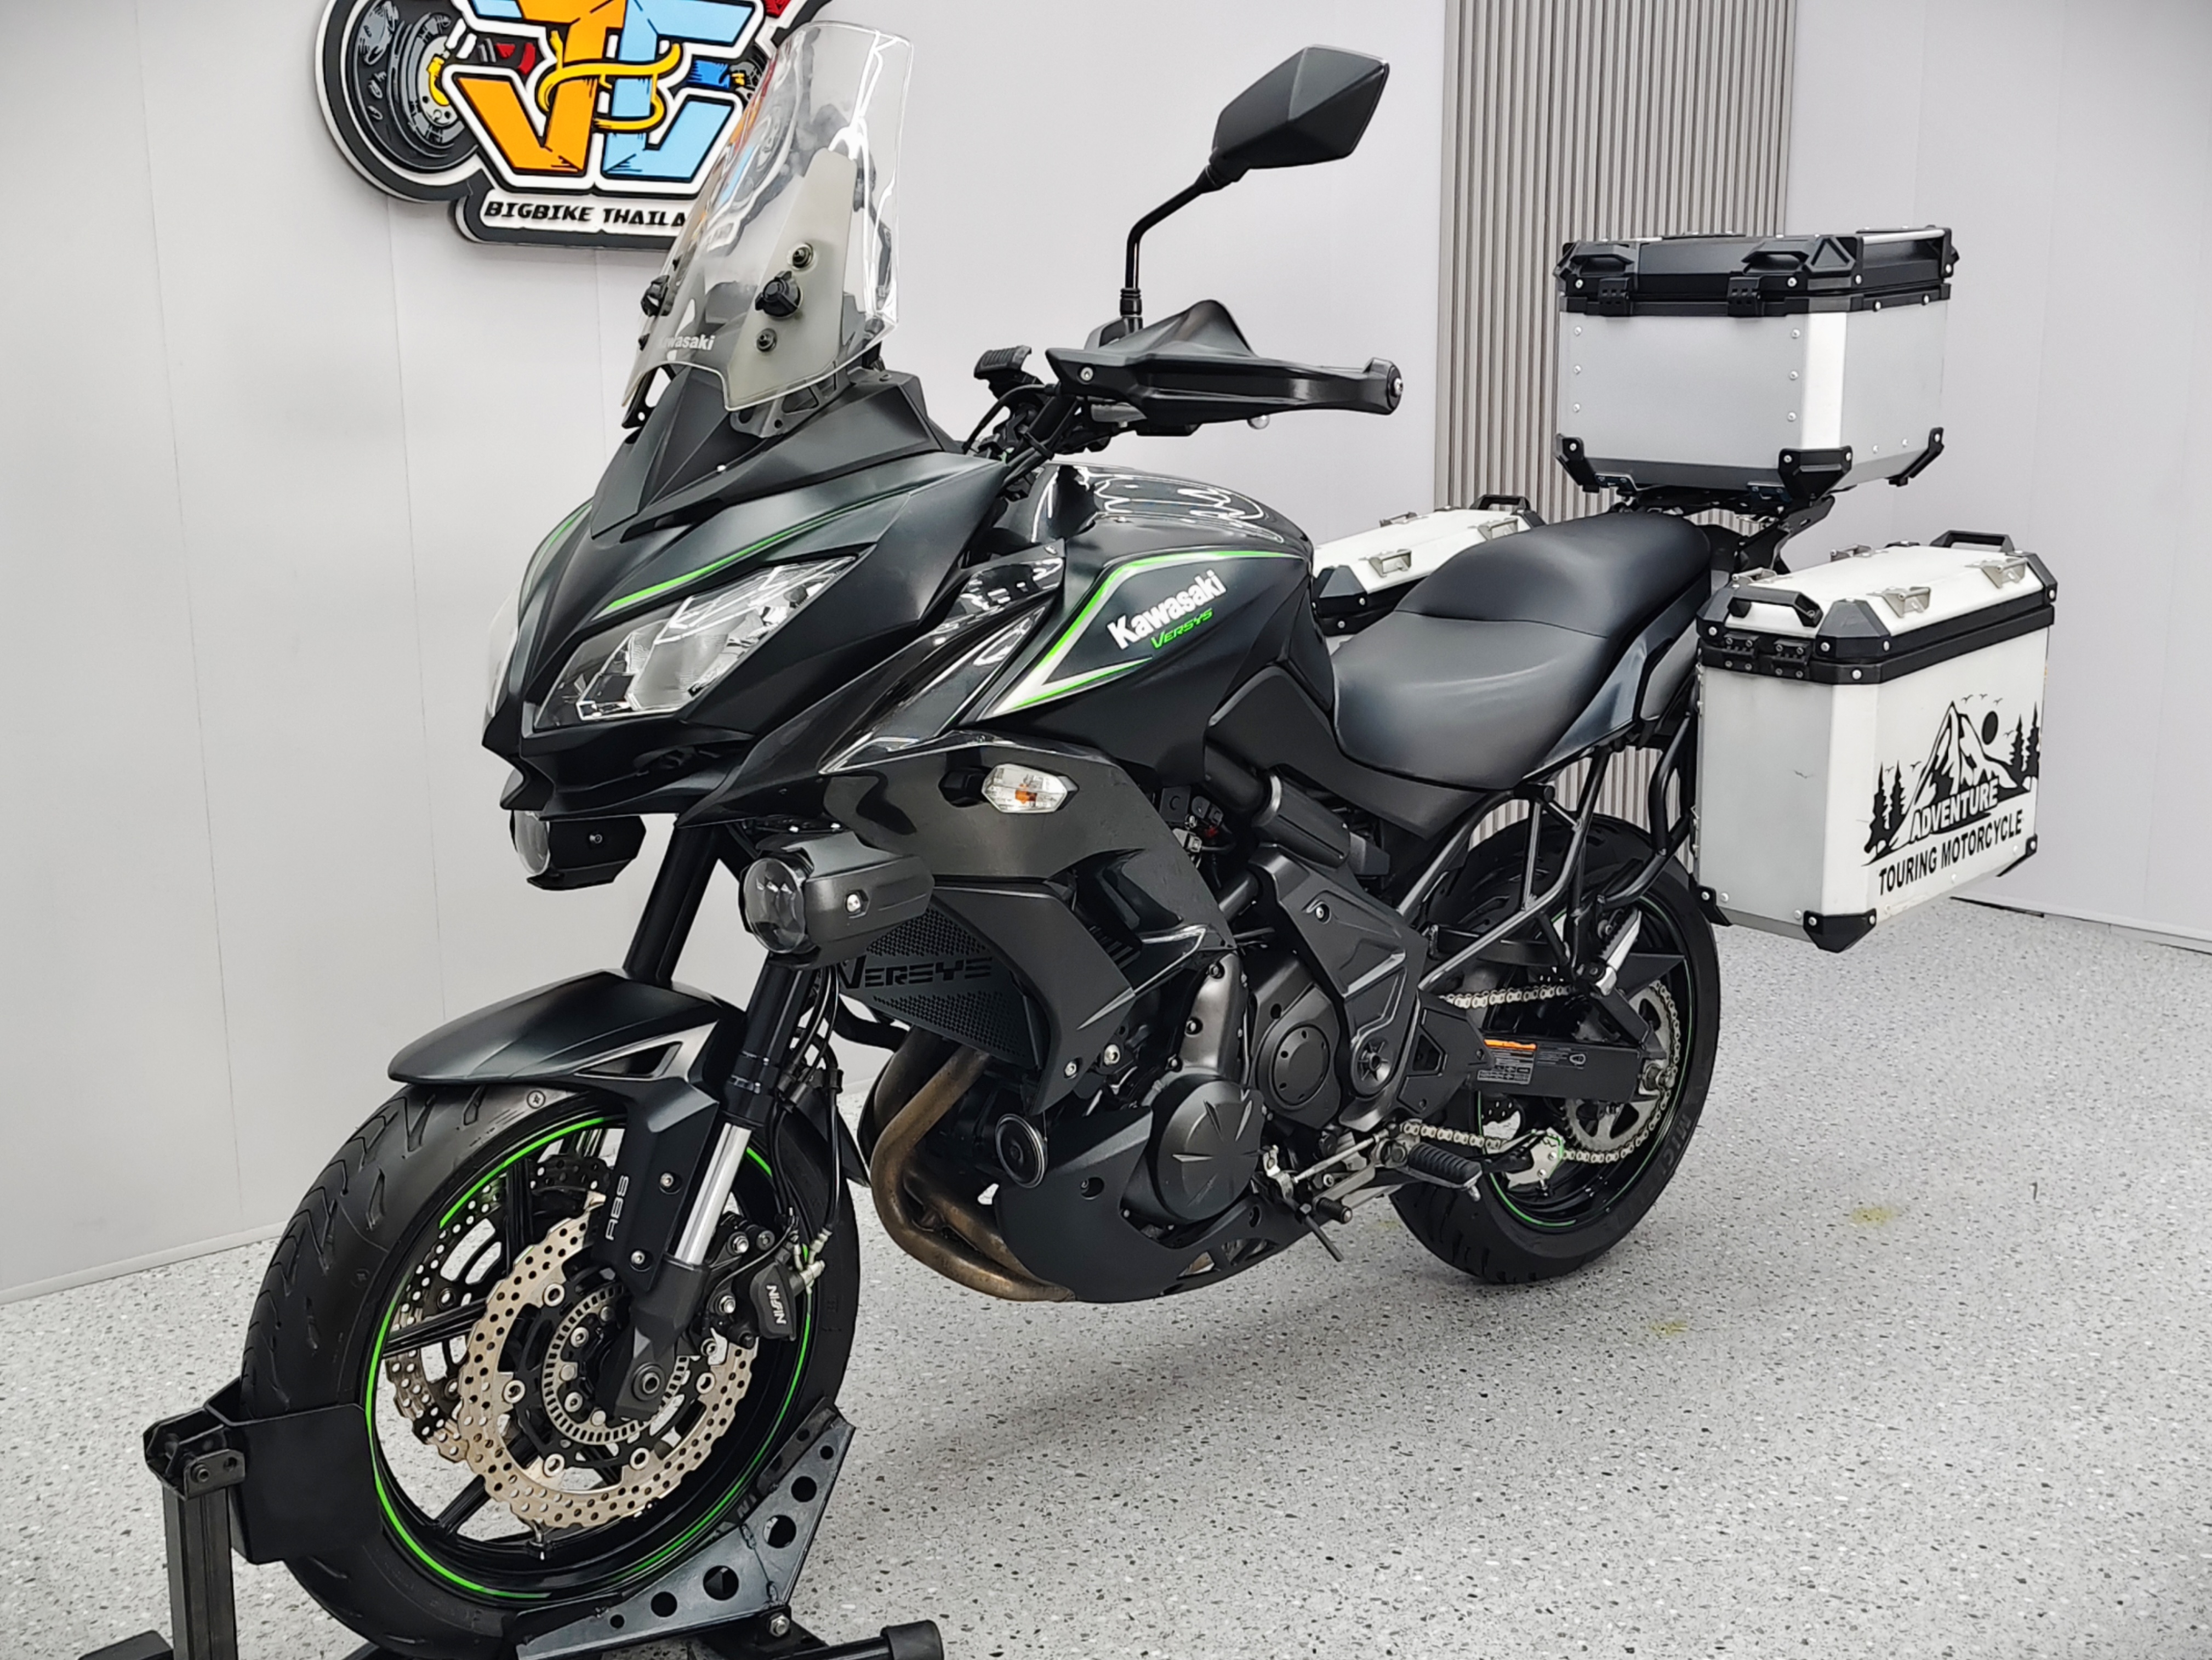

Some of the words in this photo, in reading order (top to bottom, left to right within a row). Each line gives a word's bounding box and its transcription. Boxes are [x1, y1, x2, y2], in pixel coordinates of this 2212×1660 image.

[484, 201, 595, 222] BIGBIKE
[603, 208, 686, 227] THAILA
[661, 334, 715, 350] wasaki
[1107, 570, 1226, 650] Kawasaki
[1151, 607, 1213, 649] VERSYS
[1910, 778, 1999, 842] ADVENTURE
[1879, 846, 1937, 895] TOURING
[1941, 809, 2023, 869] MOTORCYCLE
[605, 1175, 629, 1241] ABS
[766, 1285, 786, 1324] NISSIN
